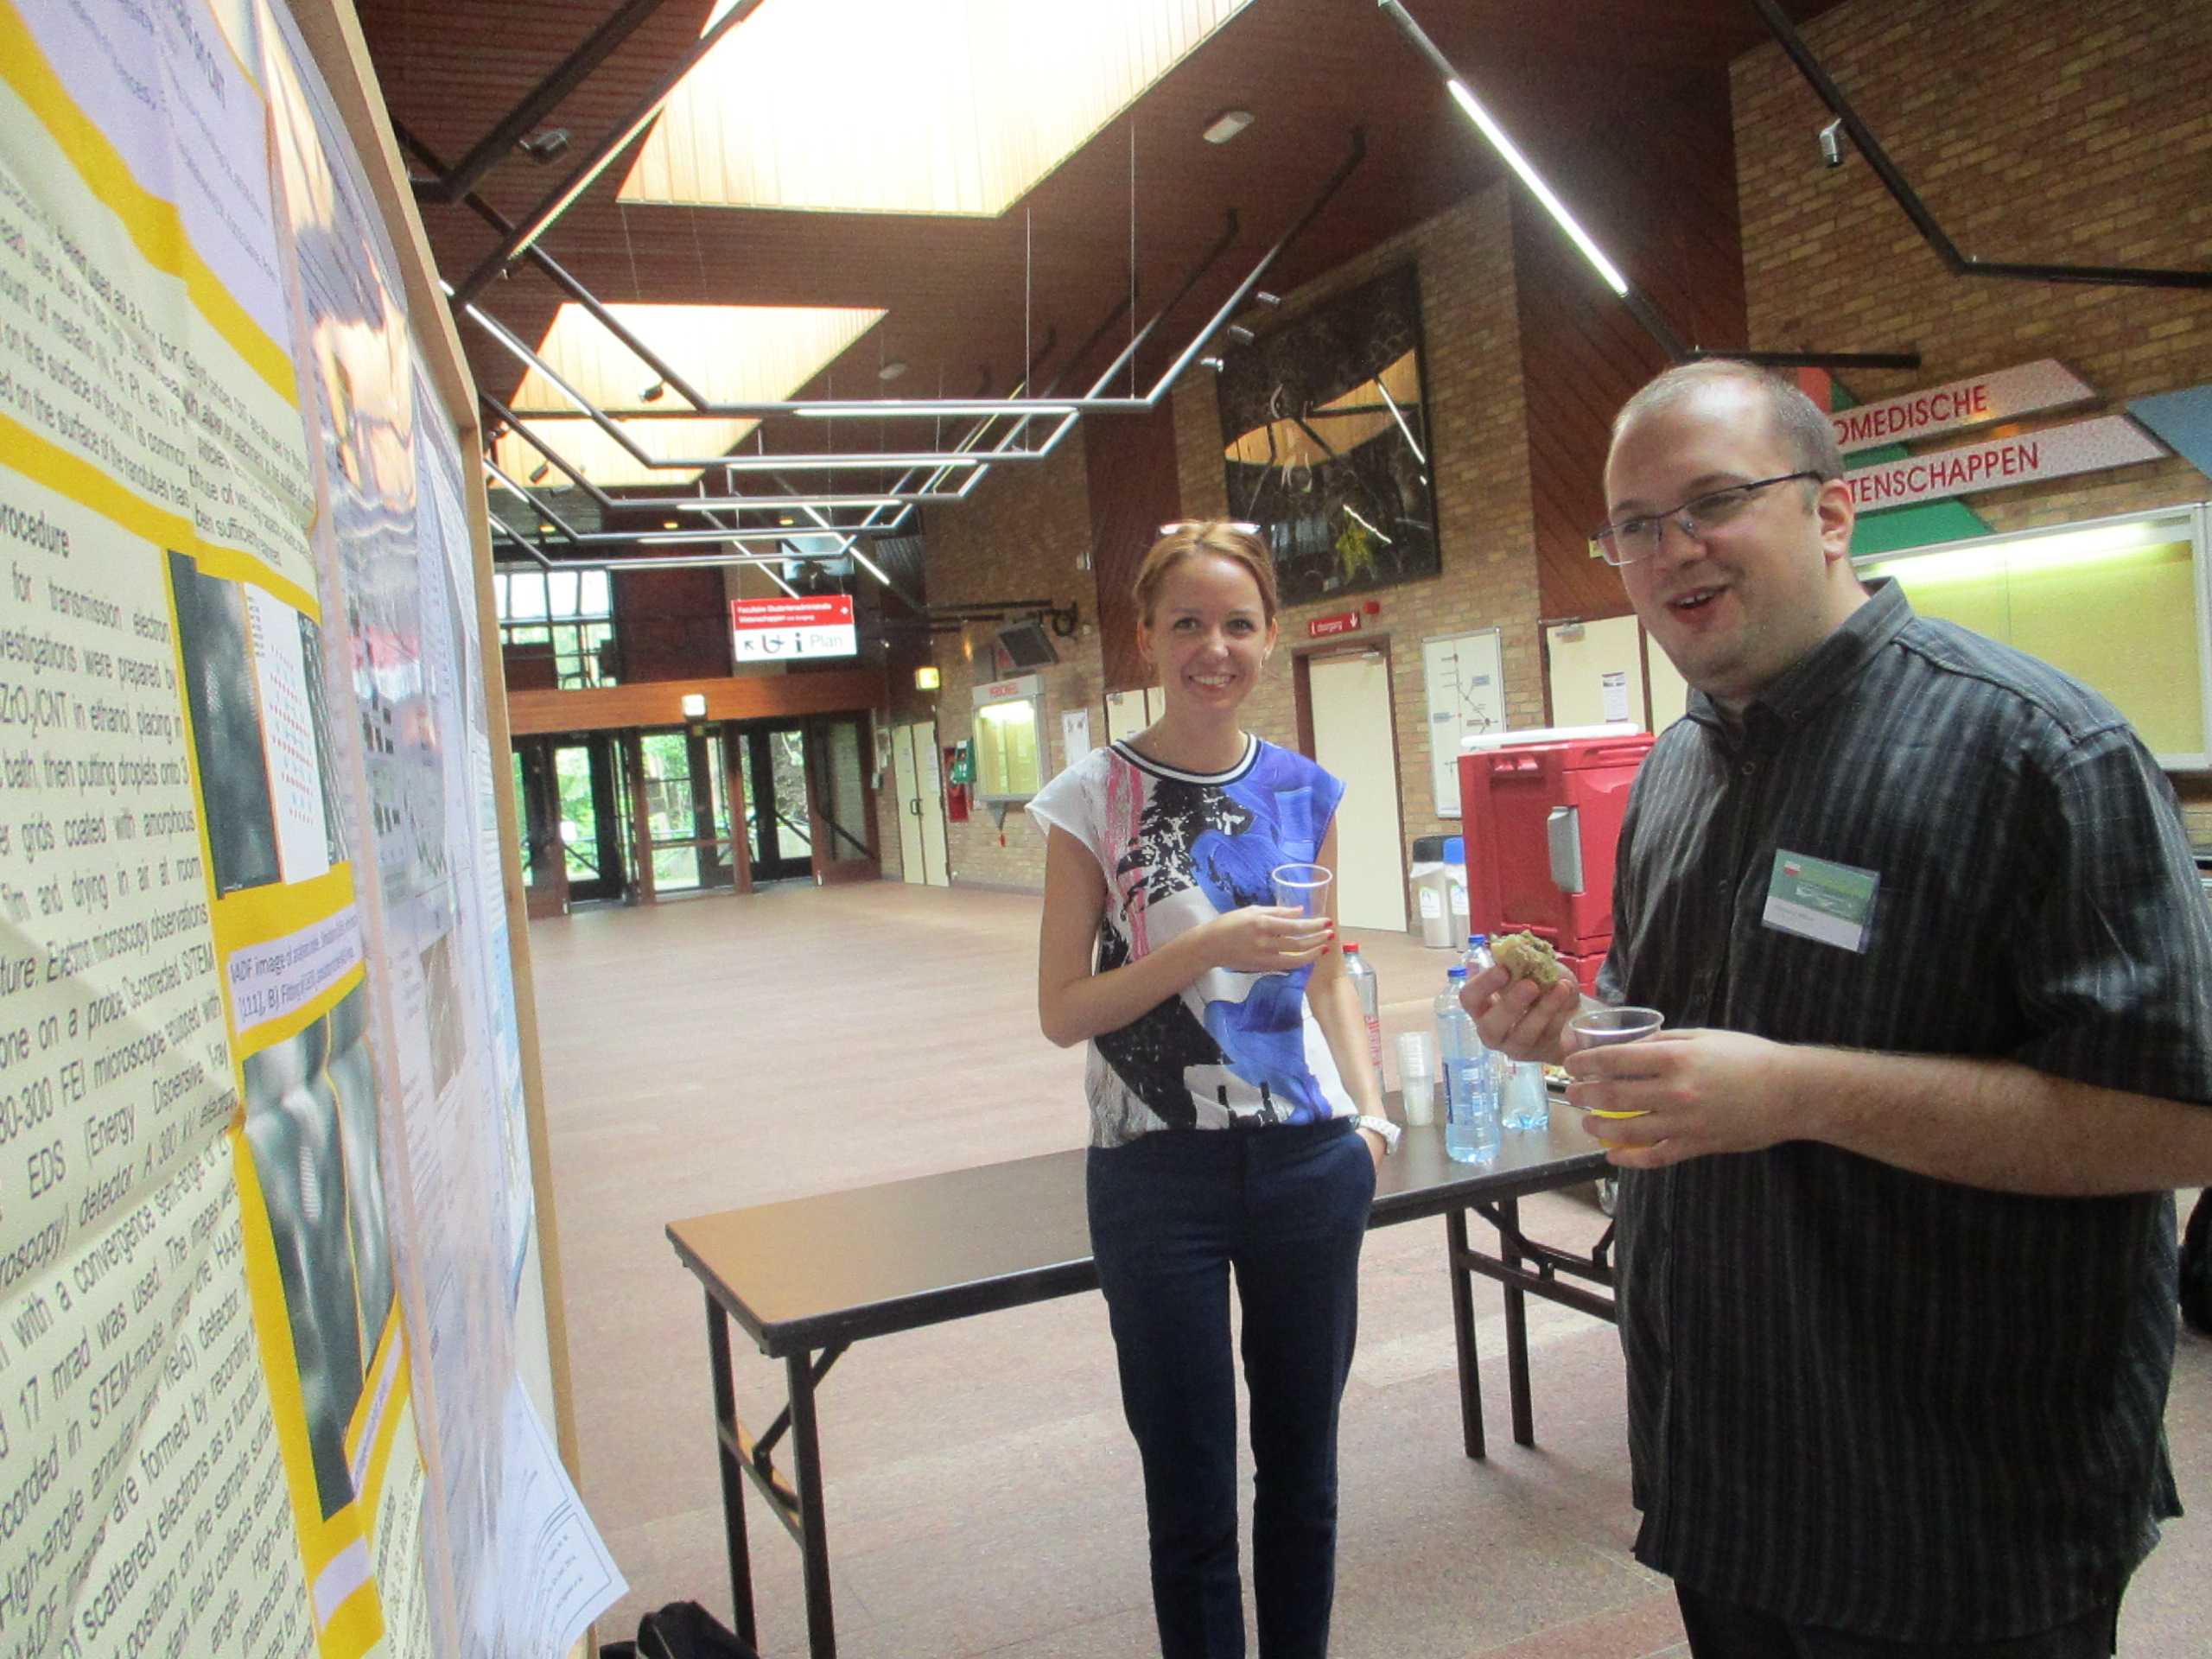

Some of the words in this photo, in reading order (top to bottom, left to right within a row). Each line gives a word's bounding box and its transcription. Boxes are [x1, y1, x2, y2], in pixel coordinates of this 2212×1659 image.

[1833, 385, 1987, 447] OMEDISCHE
[1847, 441, 2040, 505] TENSCHAPPEN
[0, 504, 69, 557] rocedure
[0, 627, 77, 675] vestigations
[810, 633, 843, 649] Plan
[0, 954, 39, 996] ture.
[0, 1026, 30, 1071] one
[39, 1014, 60, 1052] on
[68, 1007, 79, 1039] a
[60, 1058, 86, 1107] FEI
[93, 1030, 167, 1090] microscope
[28, 1139, 67, 1200] EDS
[0, 1202, 70, 1287] roscopy)
[11, 1291, 54, 1351] with
[55, 1281, 73, 1313] a
[73, 1205, 157, 1294] convergence
[52, 1325, 92, 1402] mrad
[97, 1301, 128, 1351] was
[0, 1433, 61, 1541] corded
[67, 1417, 82, 1459] in
[113, 1476, 139, 1525] are
[140, 1402, 191, 1487] formed
[83, 1517, 158, 1642] scattered
